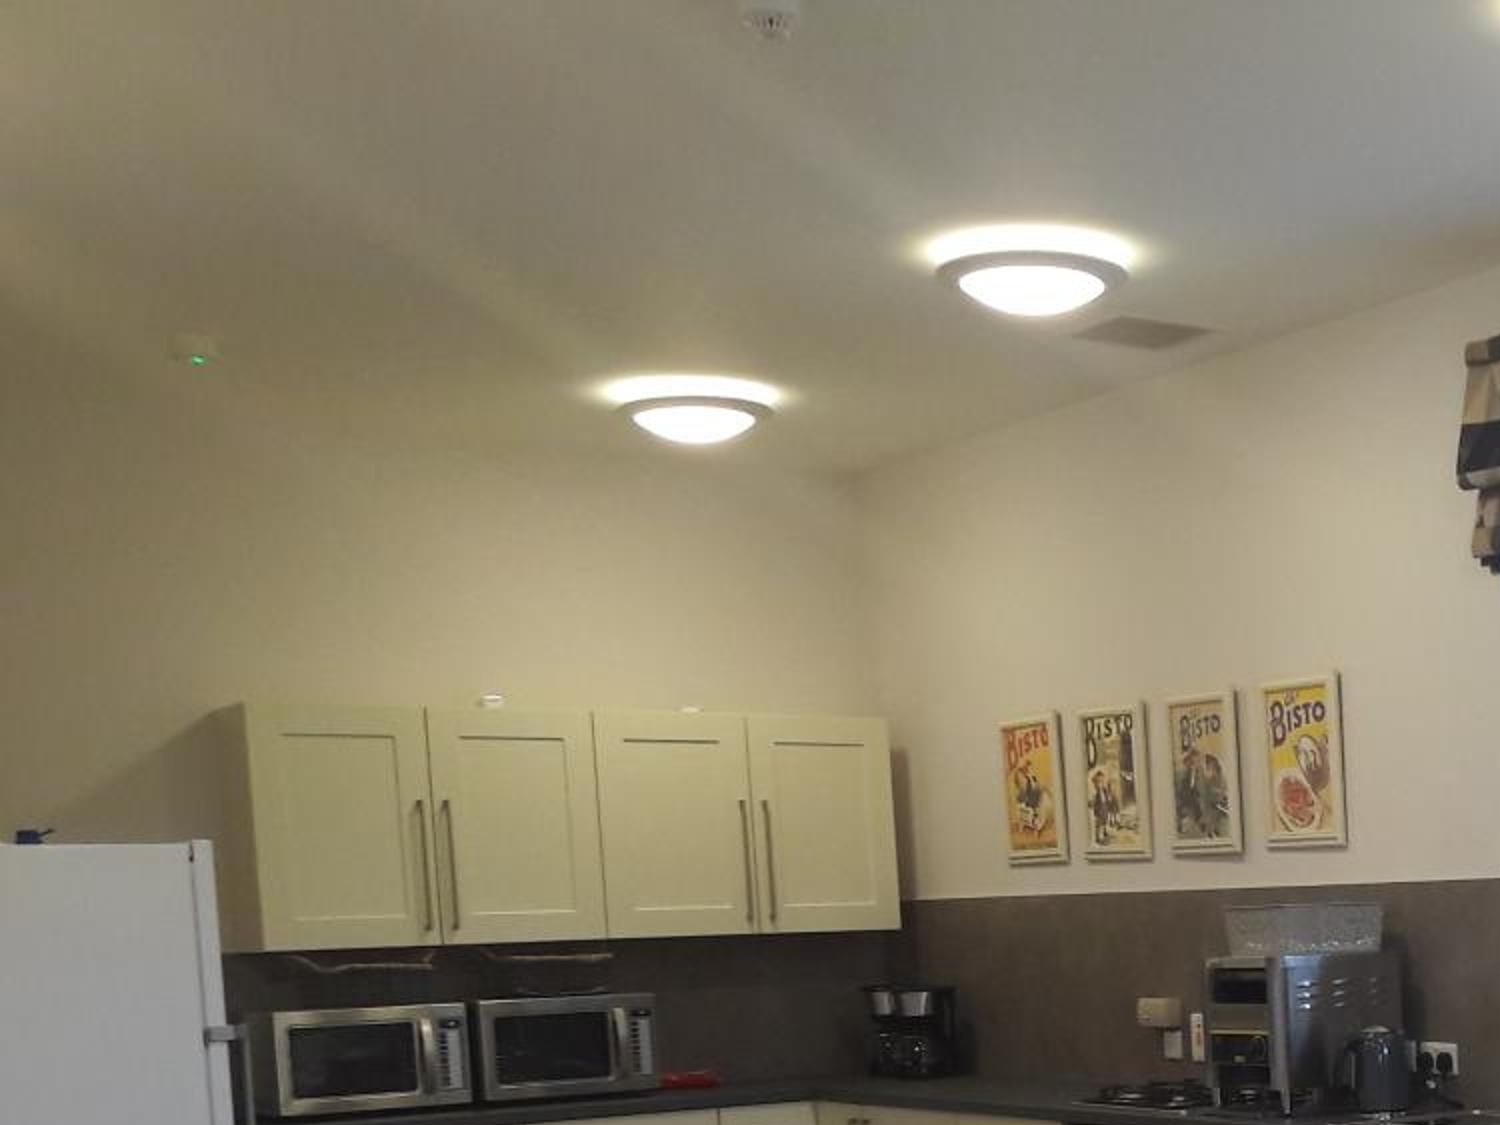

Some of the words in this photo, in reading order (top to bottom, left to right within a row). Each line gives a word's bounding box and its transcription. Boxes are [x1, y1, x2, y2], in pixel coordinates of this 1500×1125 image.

[1007, 724, 1049, 771] BISTO
[1086, 715, 1133, 768] BISTO
[1180, 714, 1220, 752] BISTO
[1270, 705, 1325, 748] BISTO
